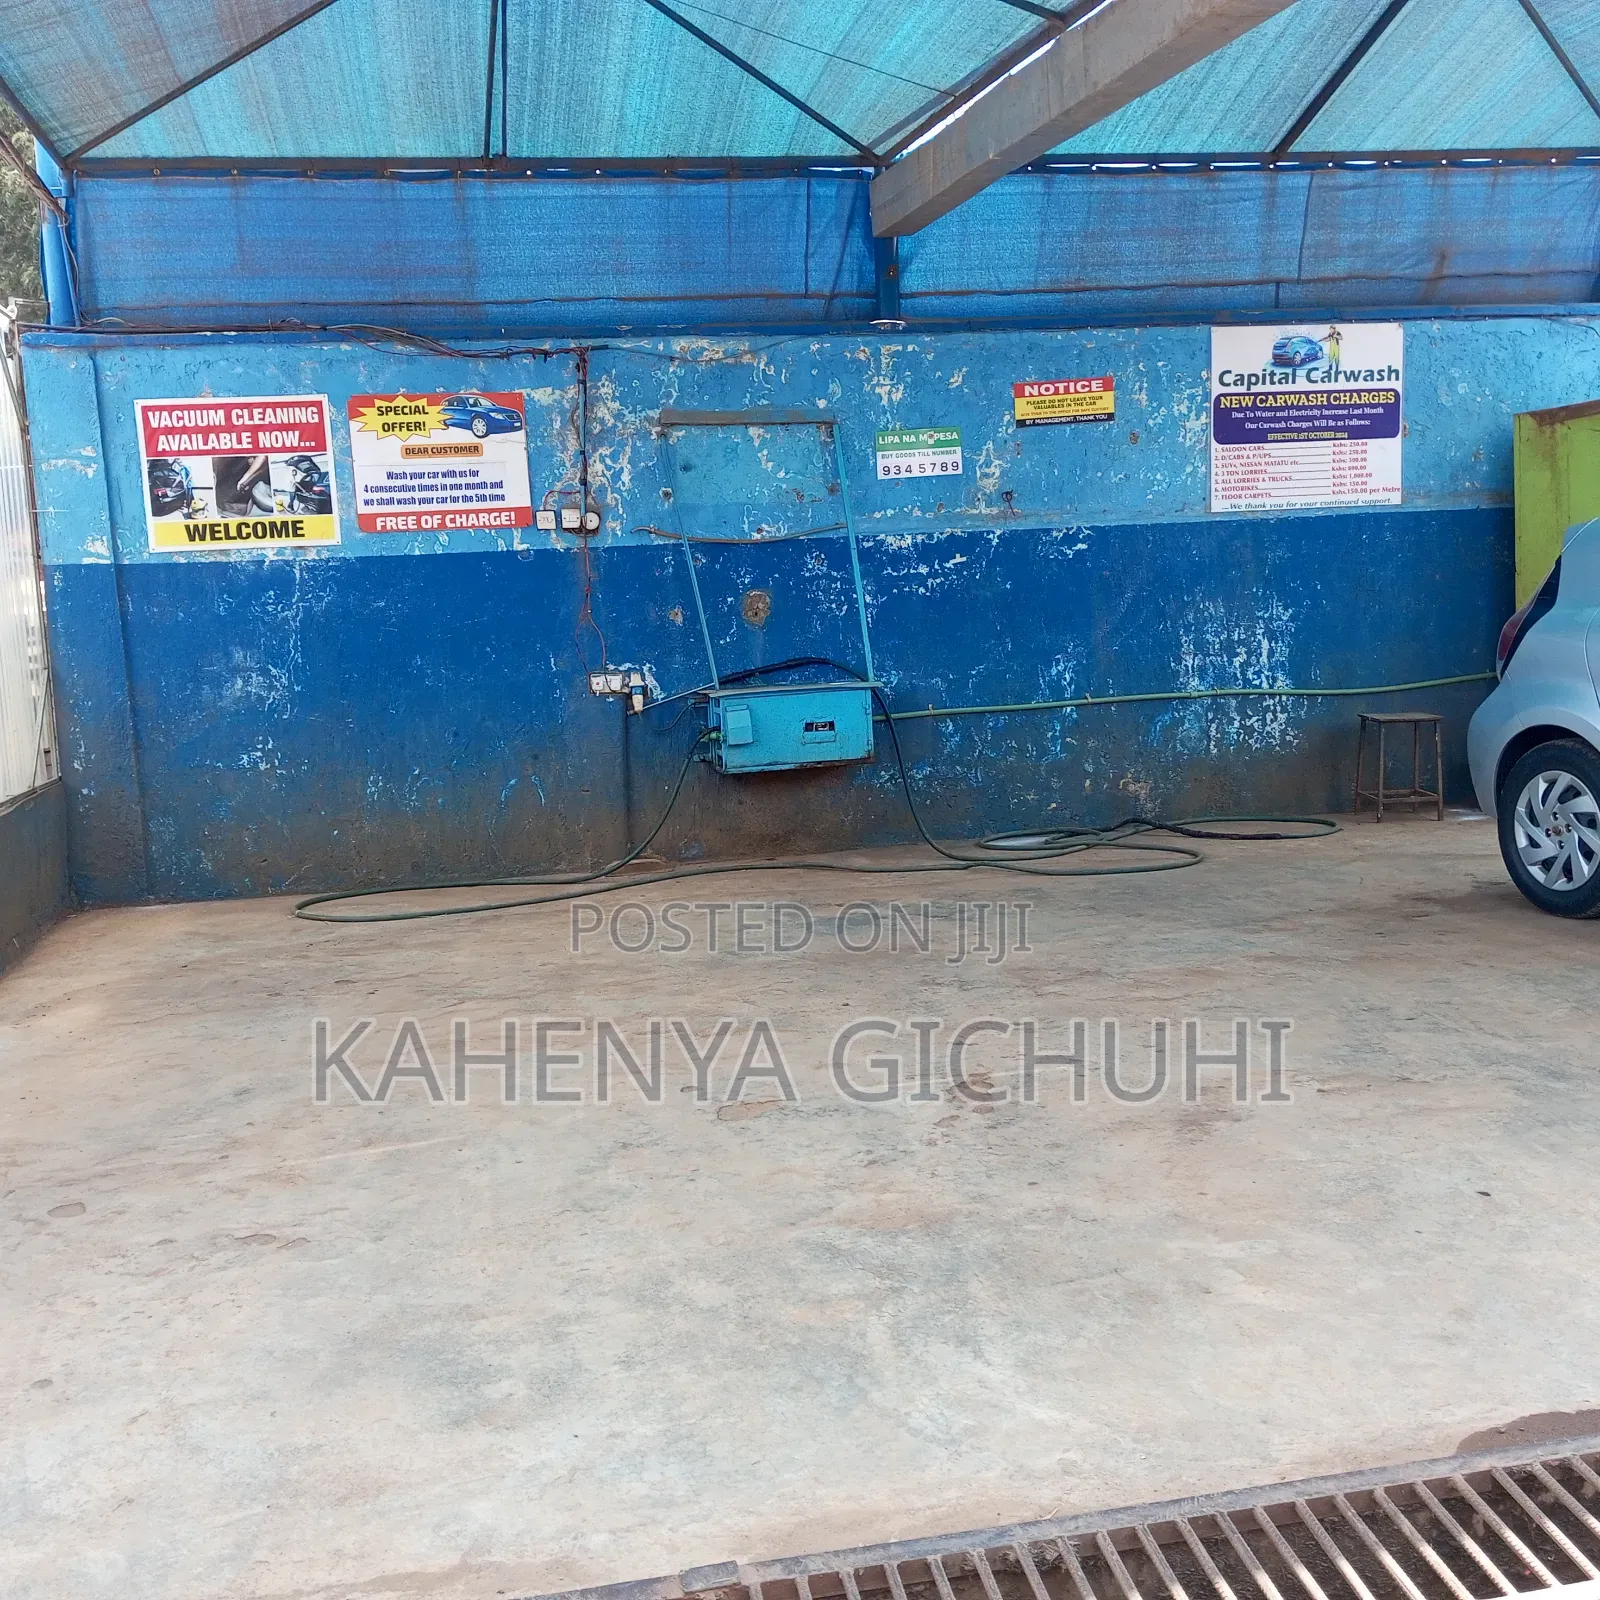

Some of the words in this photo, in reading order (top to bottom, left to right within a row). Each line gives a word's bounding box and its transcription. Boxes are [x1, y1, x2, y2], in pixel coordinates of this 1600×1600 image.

[1218, 368, 1296, 391] Capital
[1305, 365, 1400, 384] Carwash
[1024, 380, 1104, 397] NOTICE
[1220, 396, 1254, 408] NEW
[1256, 393, 1328, 407] CARWASH
[1330, 392, 1395, 405] CHARGES
[376, 405, 429, 416] SPECIAL
[1289, 408, 1321, 417] Electricity
[1364, 406, 1384, 414] Month
[147, 408, 225, 428] VACUUM
[231, 406, 319, 425] CLEANING
[382, 421, 426, 433] OFFER!
[1258, 421, 1286, 429] Carwash
[1287, 420, 1313, 428] Charges
[157, 432, 254, 452] AVAILABLE
[258, 430, 316, 448] NOW...
[878, 435, 901, 445] LIPA
[902, 434, 917, 443] NA
[1268, 432, 1298, 440] EFFECTIVE
[405, 447, 429, 455] DEAR
[431, 445, 479, 455] CUSTOMER
[386, 471, 408, 480] Wash
[408, 472, 426, 481] your
[428, 471, 440, 479] car
[441, 469, 457, 479] with
[458, 470, 468, 478] us
[469, 469, 480, 478] for
[364, 484, 369, 493] 4
[370, 483, 417, 493] consecutive
[418, 483, 439, 492] times
[440, 483, 448, 492] in
[449, 483, 463, 491] one
[464, 481, 488, 491] month
[490, 480, 504, 490] and
[364, 498, 375, 507] we
[376, 496, 395, 506] shall
[396, 496, 417, 506] wash
[418, 497, 435, 506] your
[436, 496, 448, 505] car
[449, 495, 461, 504] for
[462, 494, 474, 504] the
[474, 494, 488, 503] 5th
[488, 493, 506, 502] time
[1320, 498, 1360, 506] continued
[1361, 498, 1392, 506] support.
[376, 516, 417, 531] FREE
[420, 515, 442, 529] OF
[445, 512, 515, 528] CHARGE!
[184, 520, 305, 542] WELCOME
